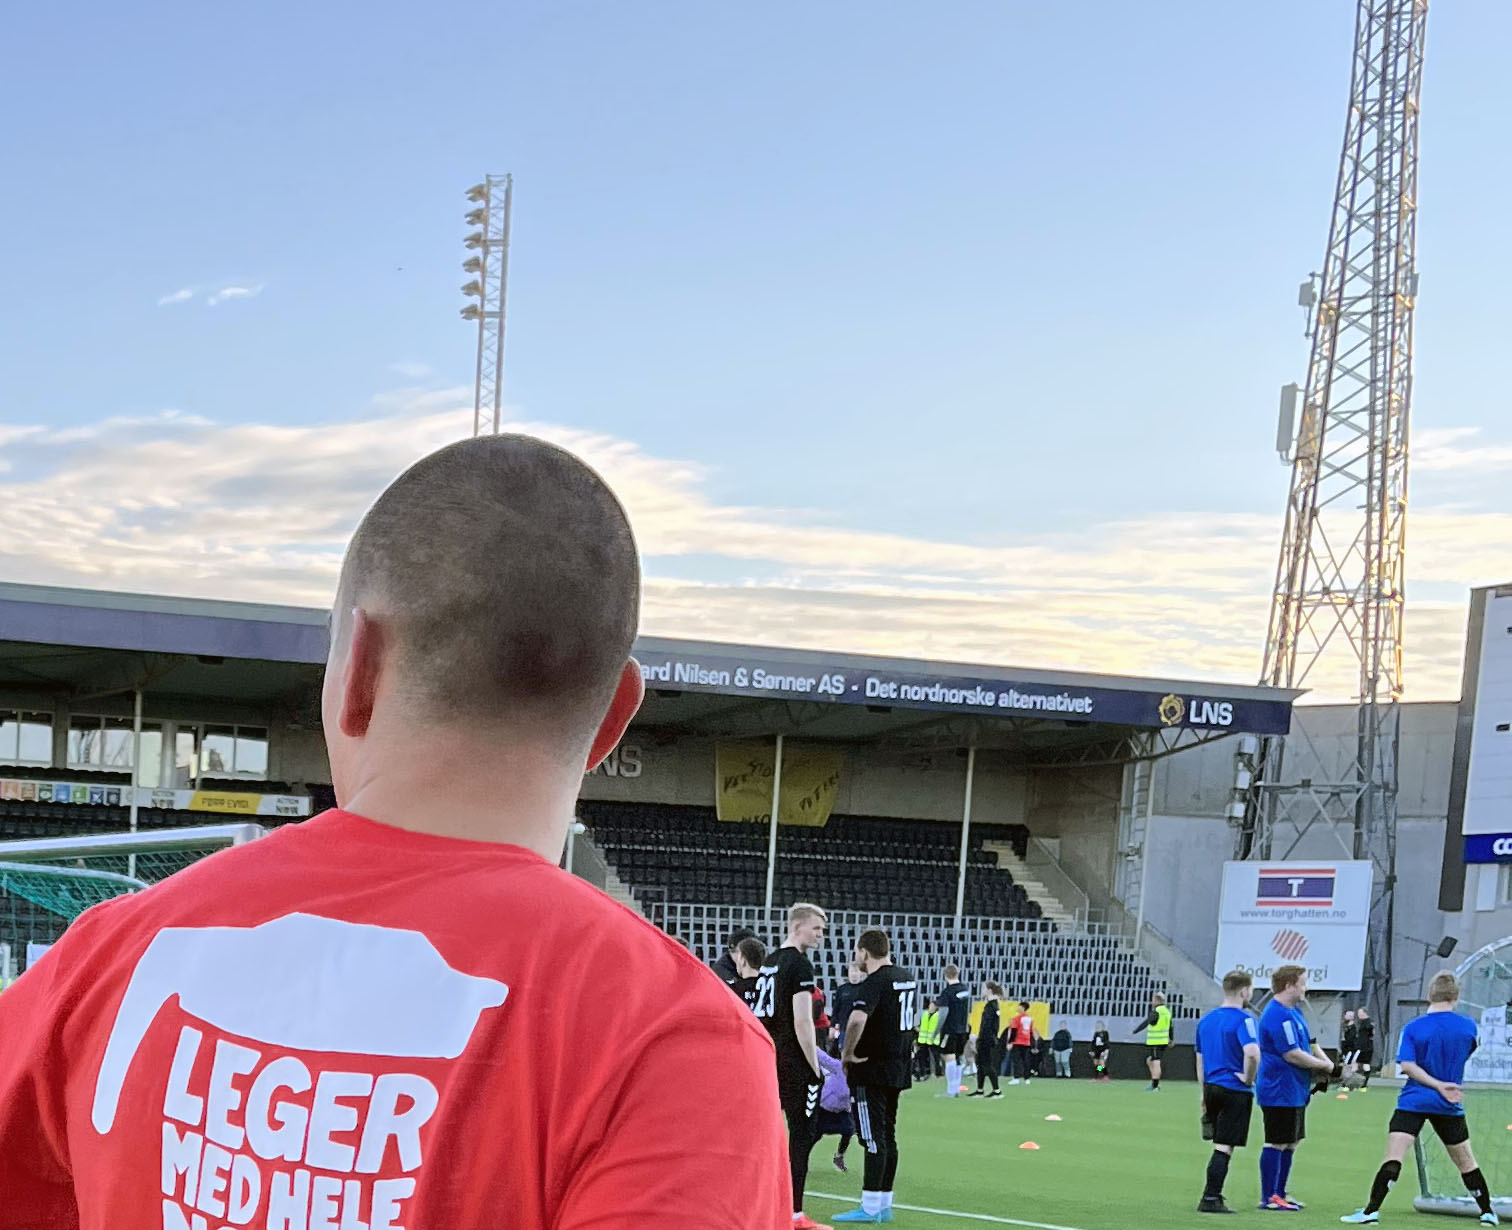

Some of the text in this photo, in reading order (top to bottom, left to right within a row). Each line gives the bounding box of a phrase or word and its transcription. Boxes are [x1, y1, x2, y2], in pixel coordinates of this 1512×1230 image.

[674, 663, 730, 687] Nilsen
[734, 667, 749, 688] &
[752, 669, 816, 694] Sønner
[818, 675, 845, 696] AS
[865, 677, 898, 700] Det
[900, 683, 995, 708] nordnorske
[998, 691, 1094, 716] alternativet
[1189, 700, 1234, 727] LNS
[589, 744, 643, 778] NS
[1288, 877, 1304, 897] T
[1240, 907, 1347, 920] www.torghatten.no
[162, 1025, 439, 1173] LEGER
[160, 1122, 261, 1225] MED
